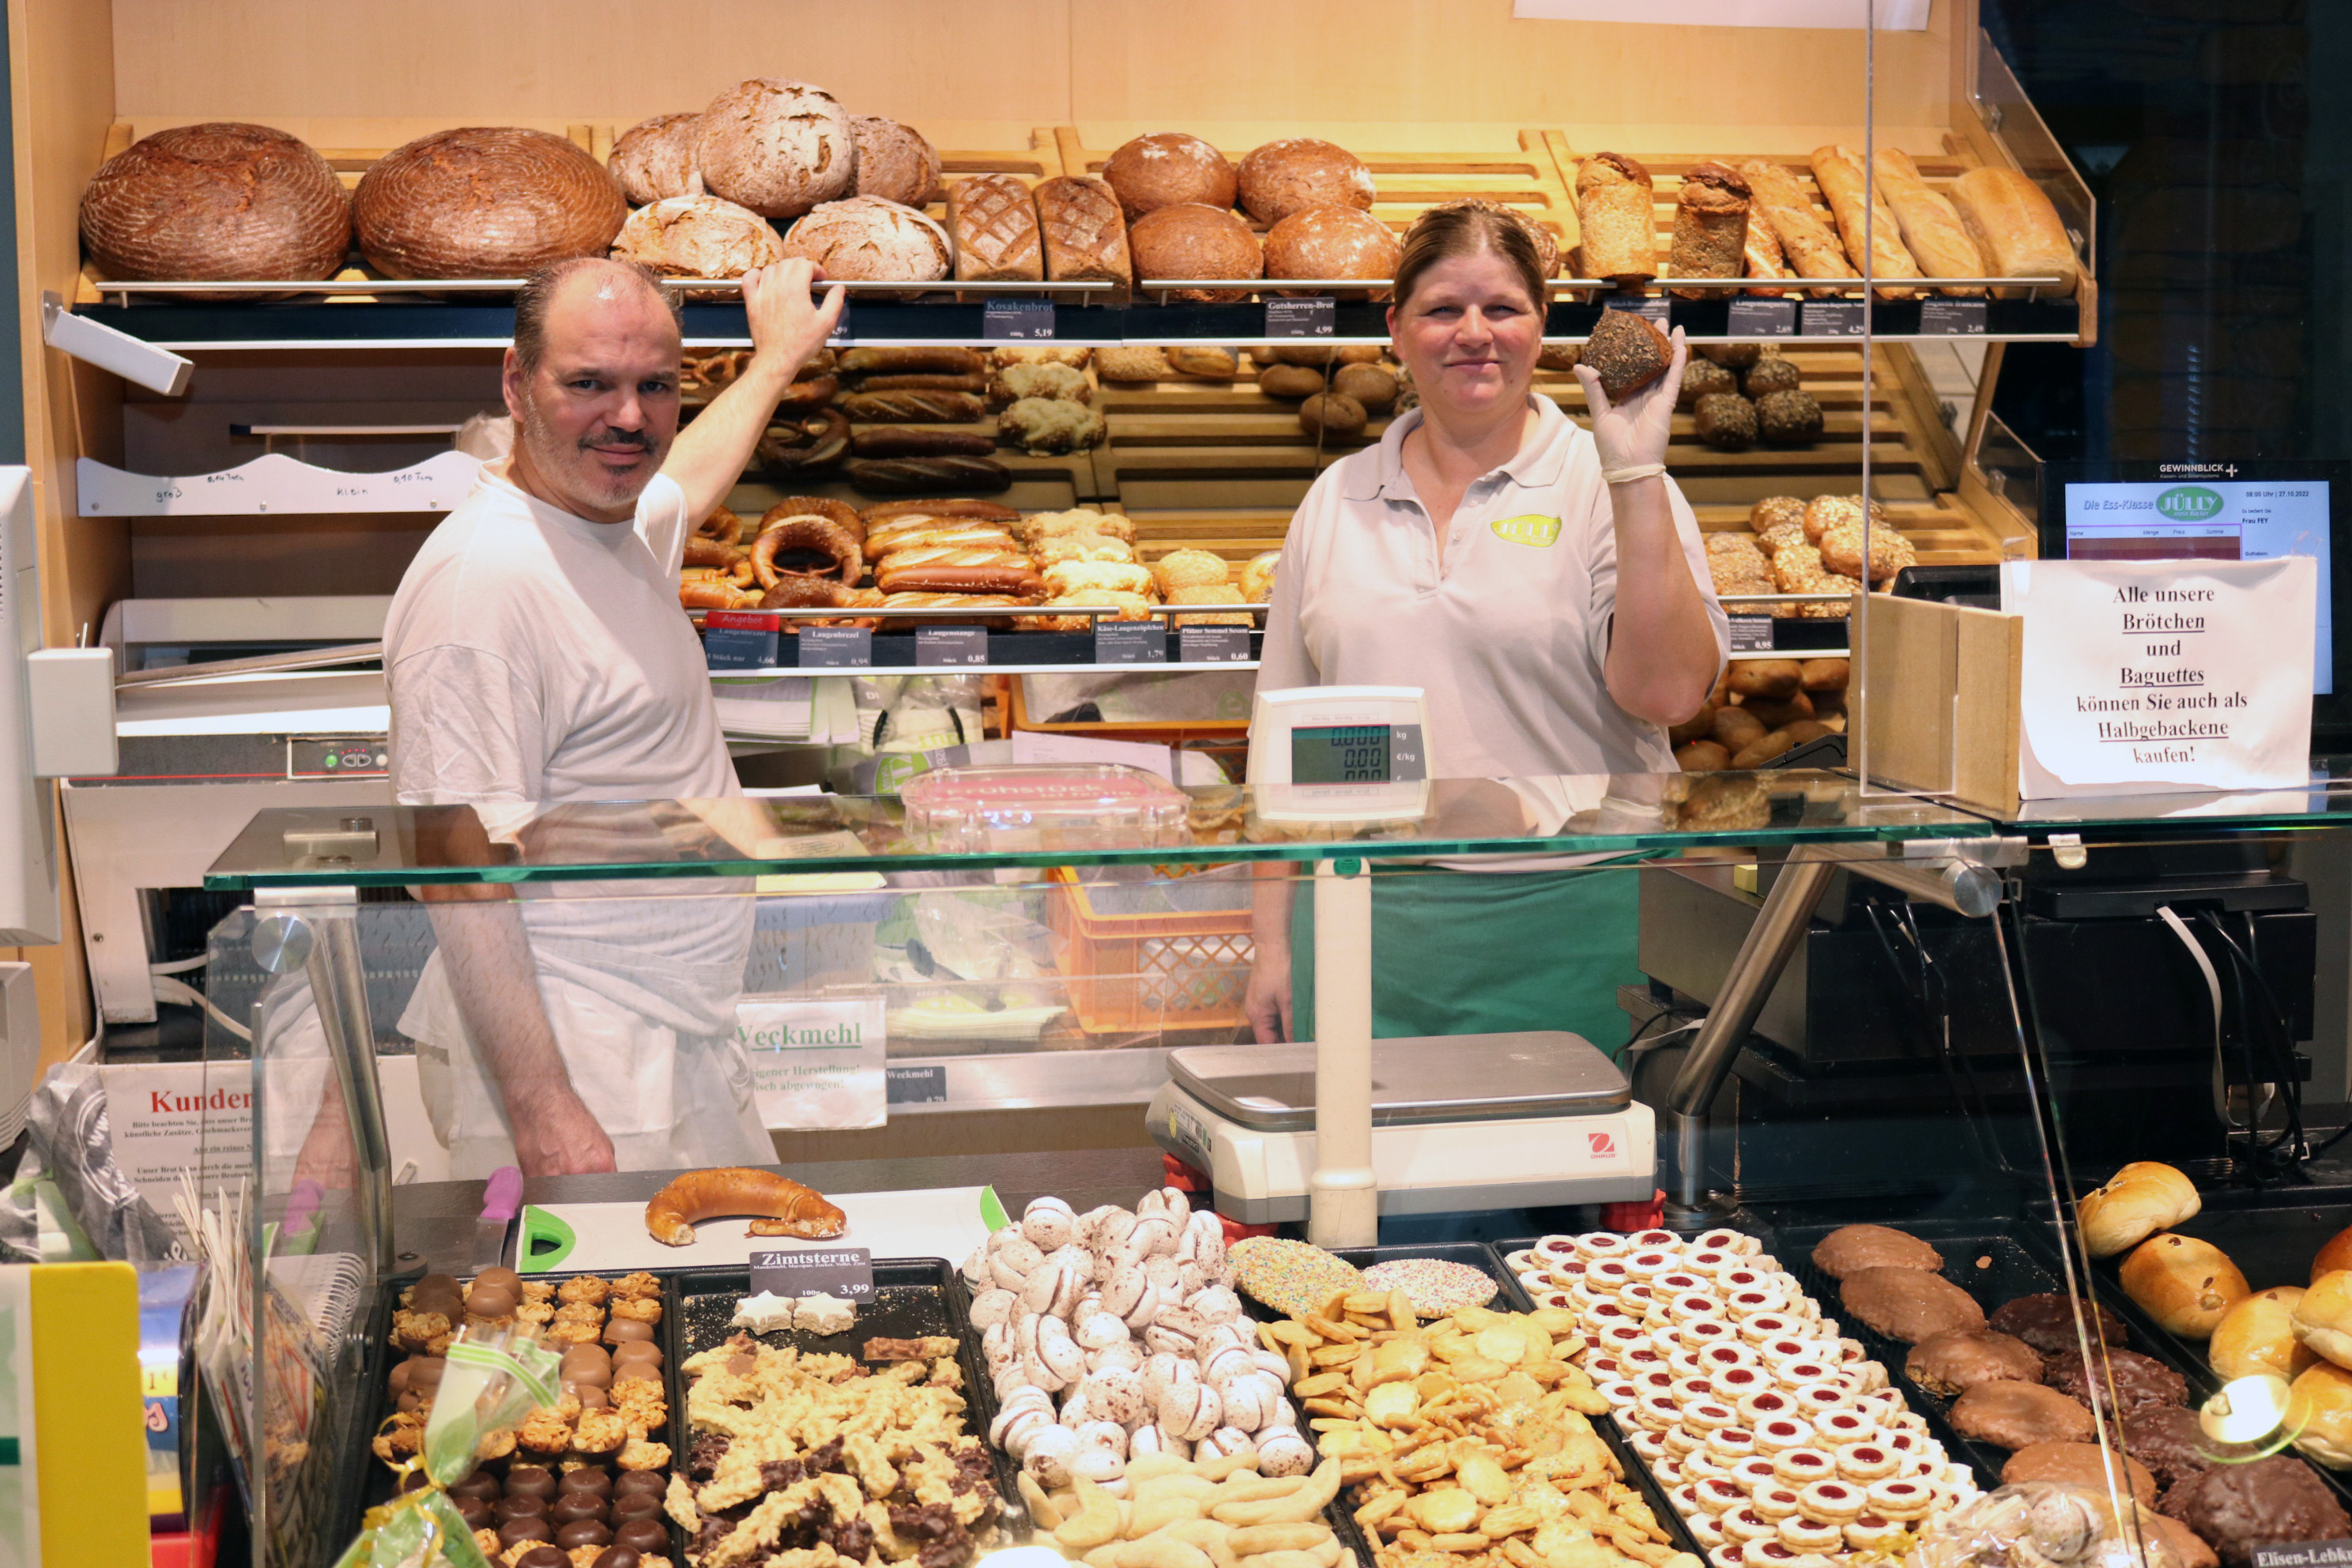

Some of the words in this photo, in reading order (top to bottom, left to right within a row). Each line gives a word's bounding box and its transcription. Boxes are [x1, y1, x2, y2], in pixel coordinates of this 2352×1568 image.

[987, 301, 1054, 312] Kosakenbrot
[1268, 301, 1334, 310] Gutsherren-Brot
[1035, 329, 1052, 337] 5,19
[1315, 326, 1333, 334] 4,99
[2160, 464, 2224, 473] GEWINNBLICK
[2084, 500, 2100, 510] Die
[2102, 500, 2154, 510] Ess-Klasse
[2160, 493, 2218, 511] JÜLLY
[2113, 586, 2148, 603] Alle
[2155, 590, 2214, 602] unsere
[722, 614, 763, 626] Angebot
[2121, 612, 2205, 630] Brötchen
[928, 629, 975, 638] Laugenstange
[1097, 624, 1164, 633] Käse-Laugenzöpfchen
[812, 631, 860, 639] Laugenbrezel
[2147, 640, 2180, 657] und
[712, 654, 731, 662] Stück
[757, 656, 775, 665] 4,66
[967, 654, 985, 663] 0,85
[1148, 650, 1164, 659] 1,79
[1231, 653, 1249, 662] 0,60
[2120, 667, 2204, 687] Baguettes
[2077, 695, 2139, 712] können
[2147, 694, 2172, 710] Sie
[2177, 692, 2218, 709] auch
[2224, 692, 2248, 707] als
[1396, 730, 1407, 740] kg
[2098, 719, 2229, 741] Halbgebackene
[1331, 726, 1381, 747] 0,000
[1344, 748, 1381, 768] 0,00
[1396, 753, 1415, 762] €/kg
[2133, 746, 2196, 763] kaufen!
[793, 1064, 860, 1076] Herstellung!
[887, 1069, 933, 1080] Weckmehl
[756, 1082, 776, 1091] isch
[780, 1080, 845, 1091] abgewogen!
[762, 1253, 860, 1265] Zimtsterne
[840, 1283, 869, 1296] 3,99
[2257, 1547, 2352, 1568] Elisen-Lebku
